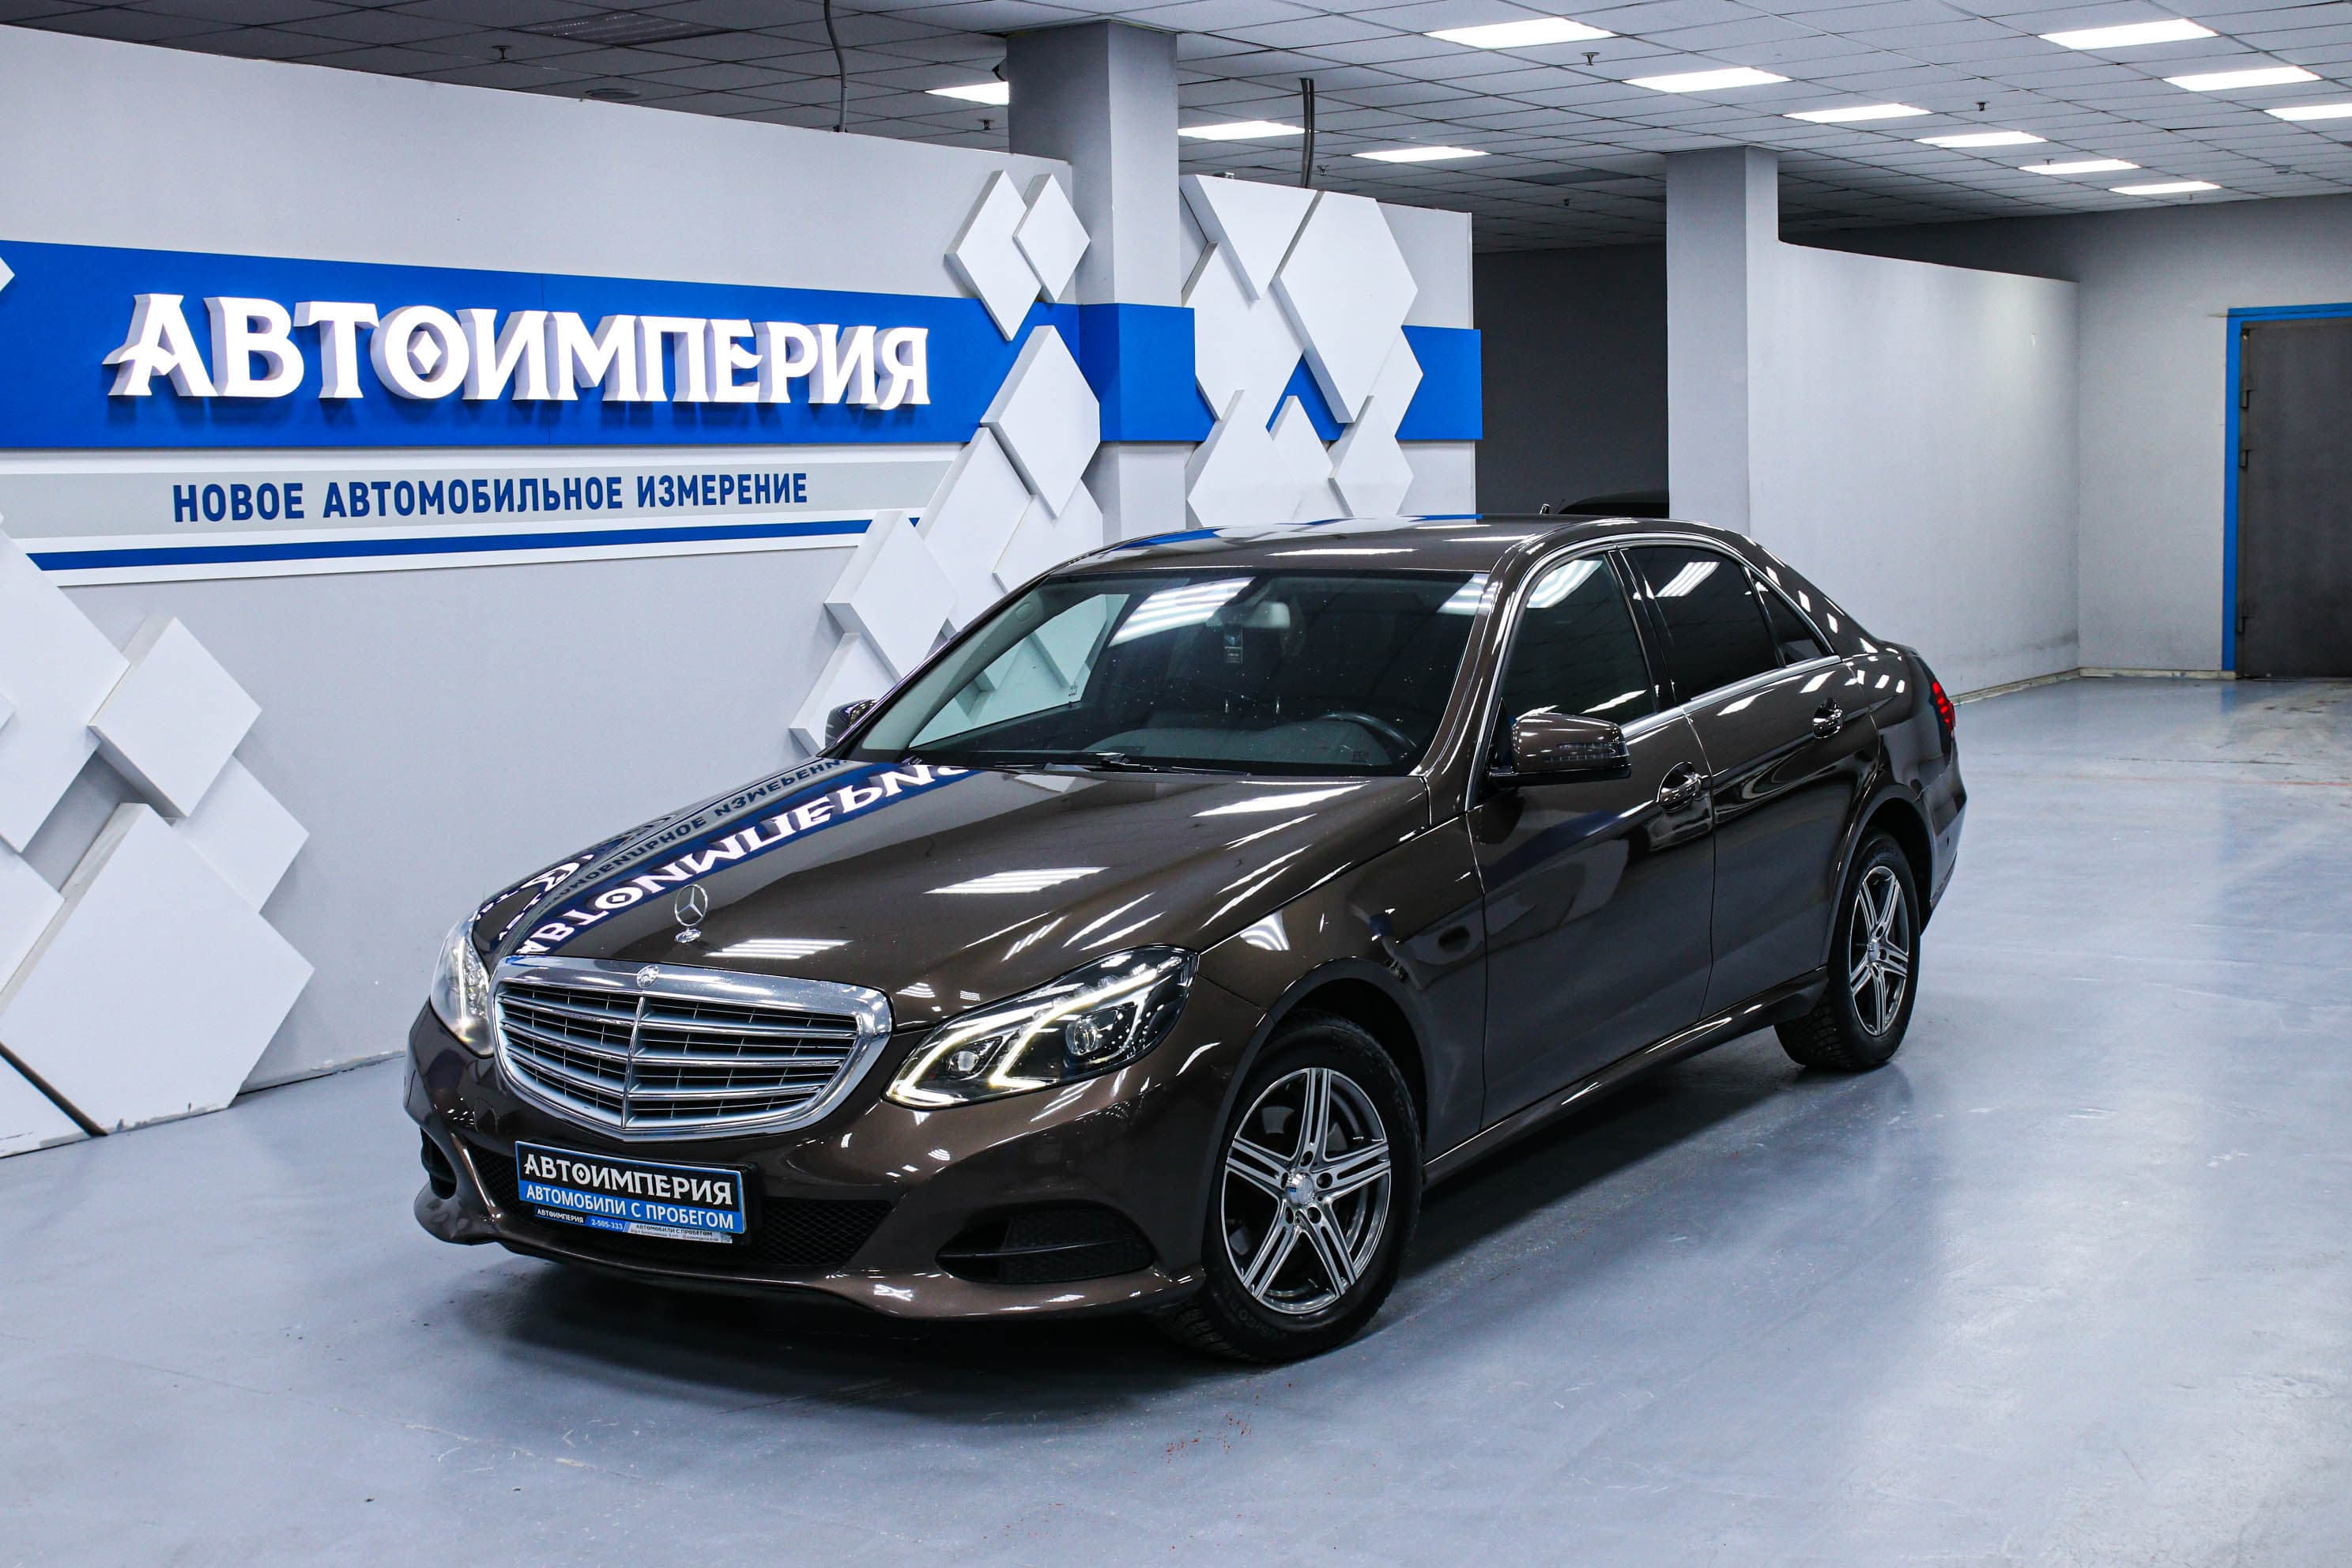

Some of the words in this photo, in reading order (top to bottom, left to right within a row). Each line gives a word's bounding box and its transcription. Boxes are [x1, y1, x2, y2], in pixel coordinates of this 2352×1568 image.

[102, 293, 931, 410] АВТОИМПЕРИЯ
[173, 482, 305, 522] НОВОЕ
[322, 477, 623, 518] АВТОМОБИЛЬНОЕ
[637, 473, 808, 508] ИЗМЕРЕНИЕ
[523, 1153, 733, 1206] АВТОИМПЕРИЯ
[526, 1184, 627, 1216] АВТОМОБИЛИ
[631, 1202, 642, 1218] С
[646, 1204, 734, 1230] ПРОБЕГОМ
[537, 1208, 584, 1223] АВТОИМПЕРИЯ
[590, 1219, 624, 1230] 2-505-333
